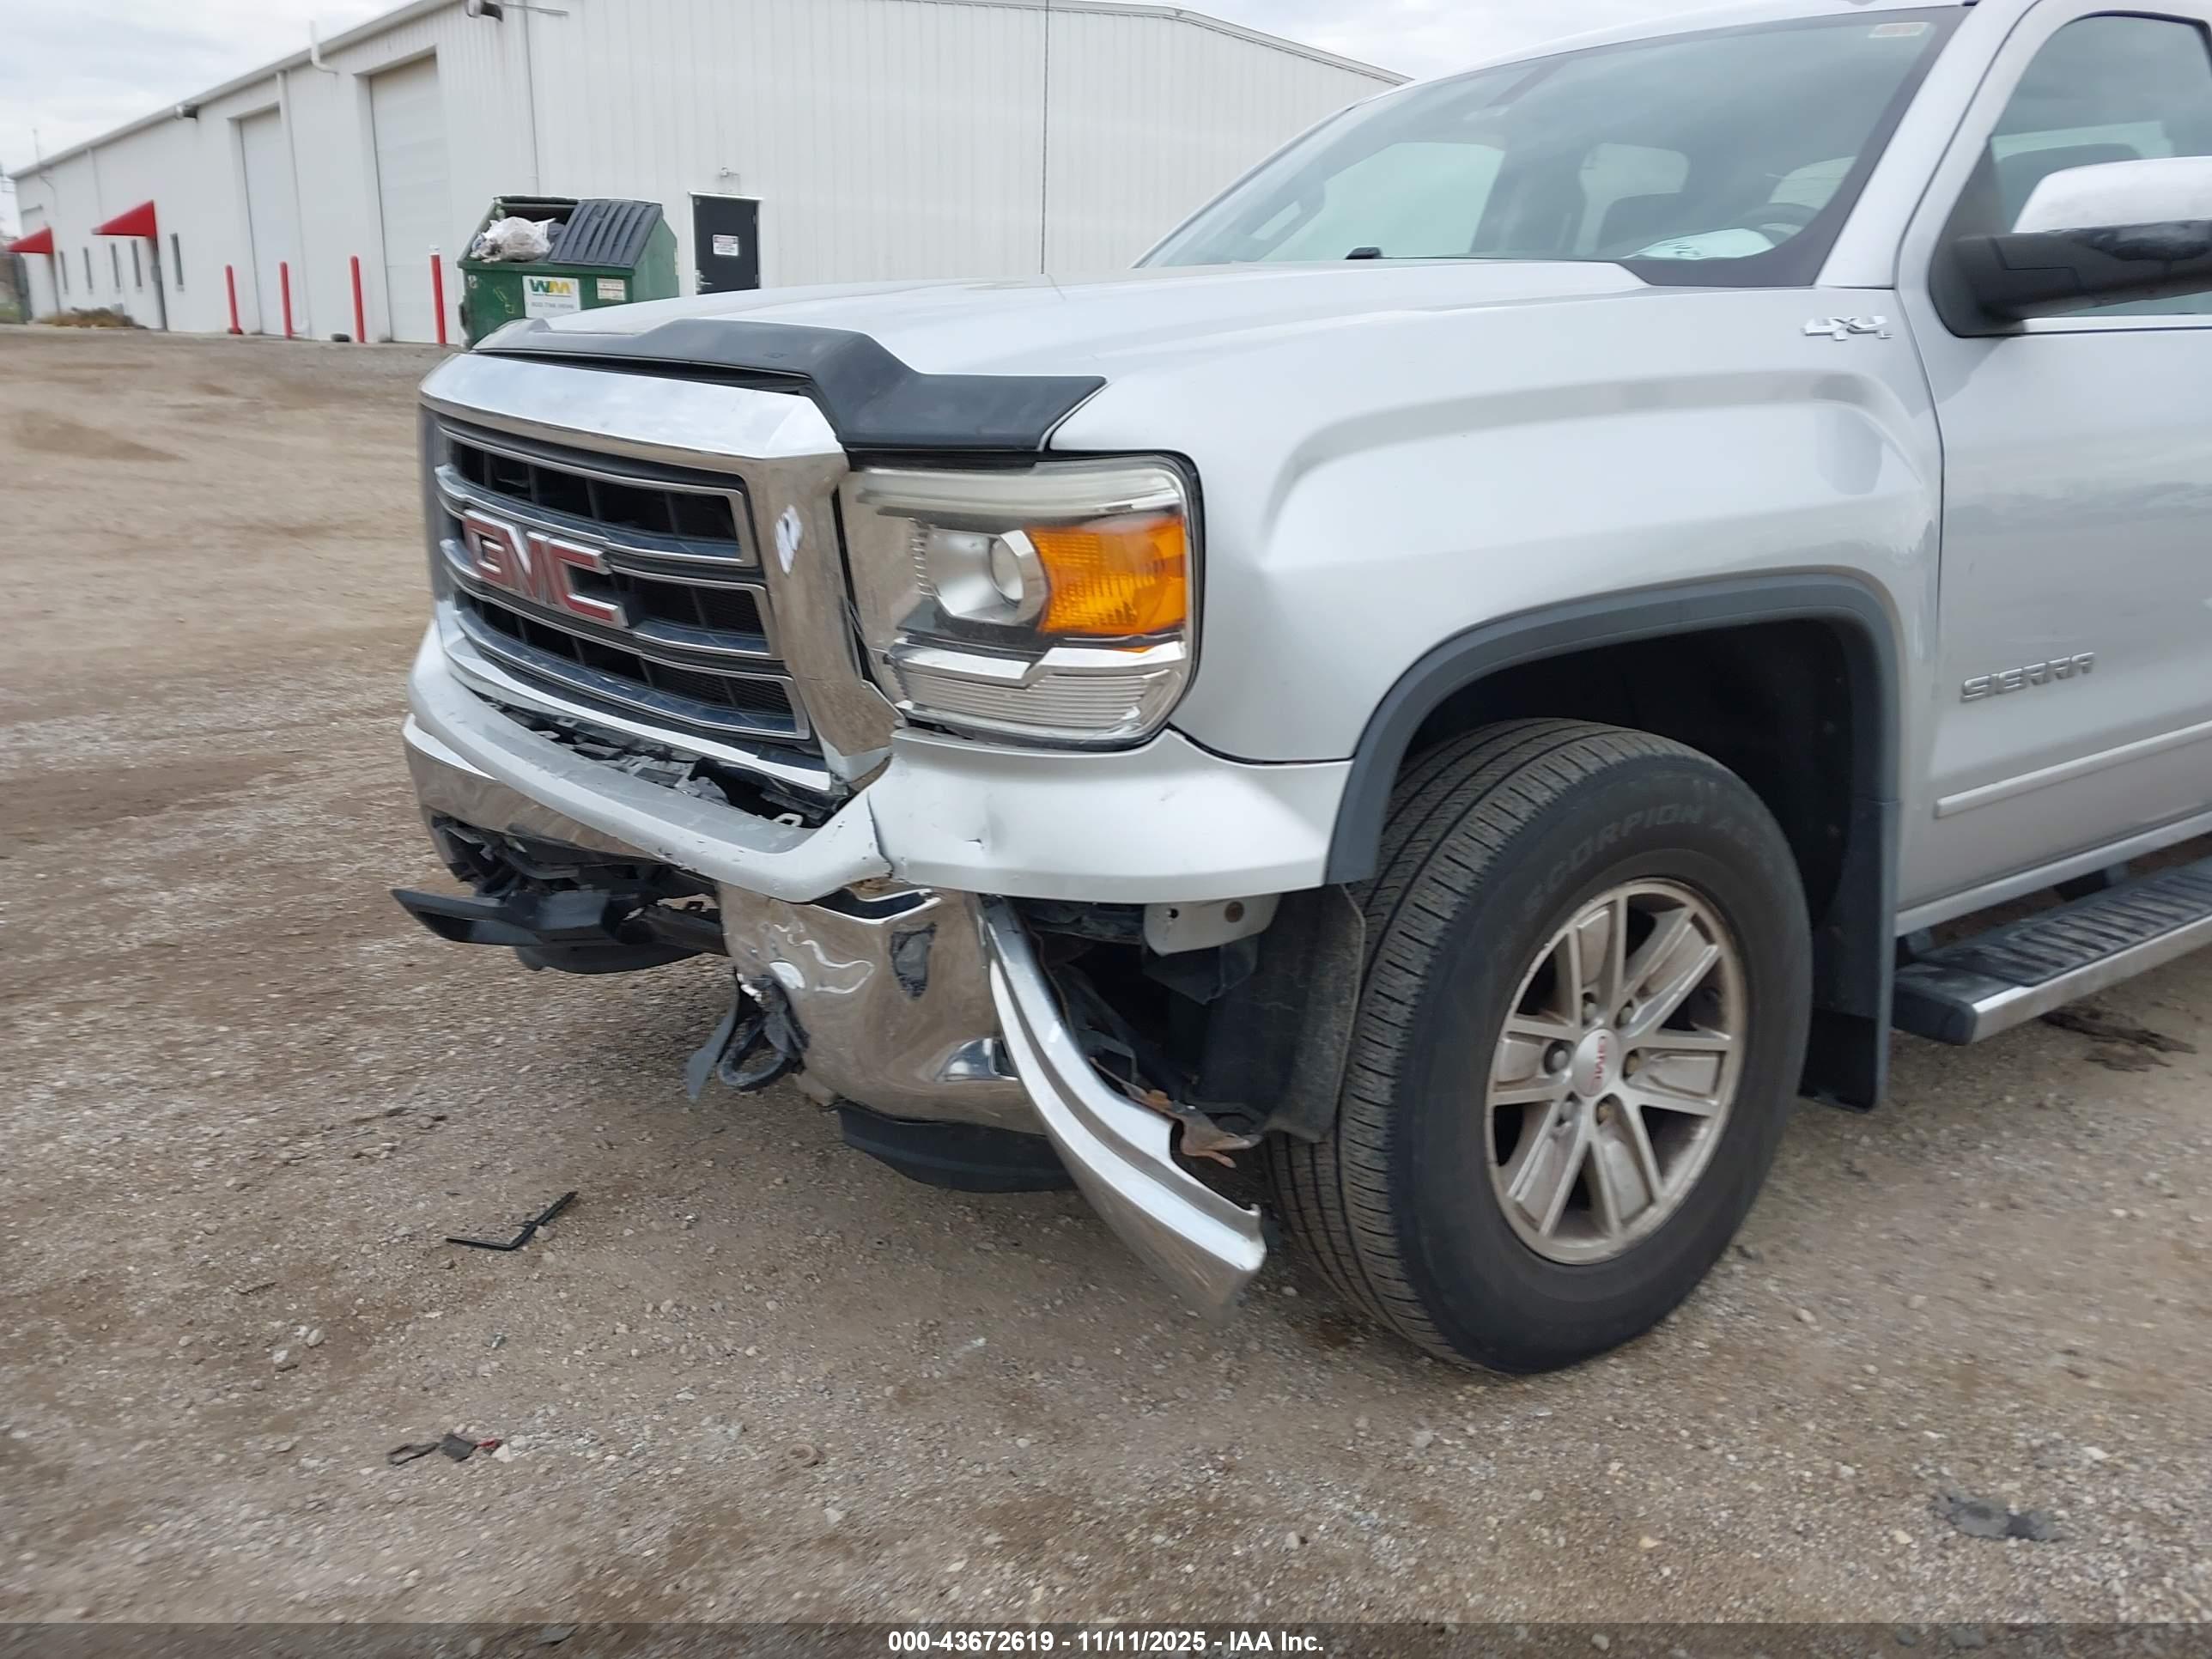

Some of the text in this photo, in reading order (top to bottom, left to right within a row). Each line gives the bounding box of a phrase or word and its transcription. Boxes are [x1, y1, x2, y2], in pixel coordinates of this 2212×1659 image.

[528, 278, 571, 294] WM
[462, 508, 629, 628] GMC
[1960, 652, 2095, 703] SIERRA
